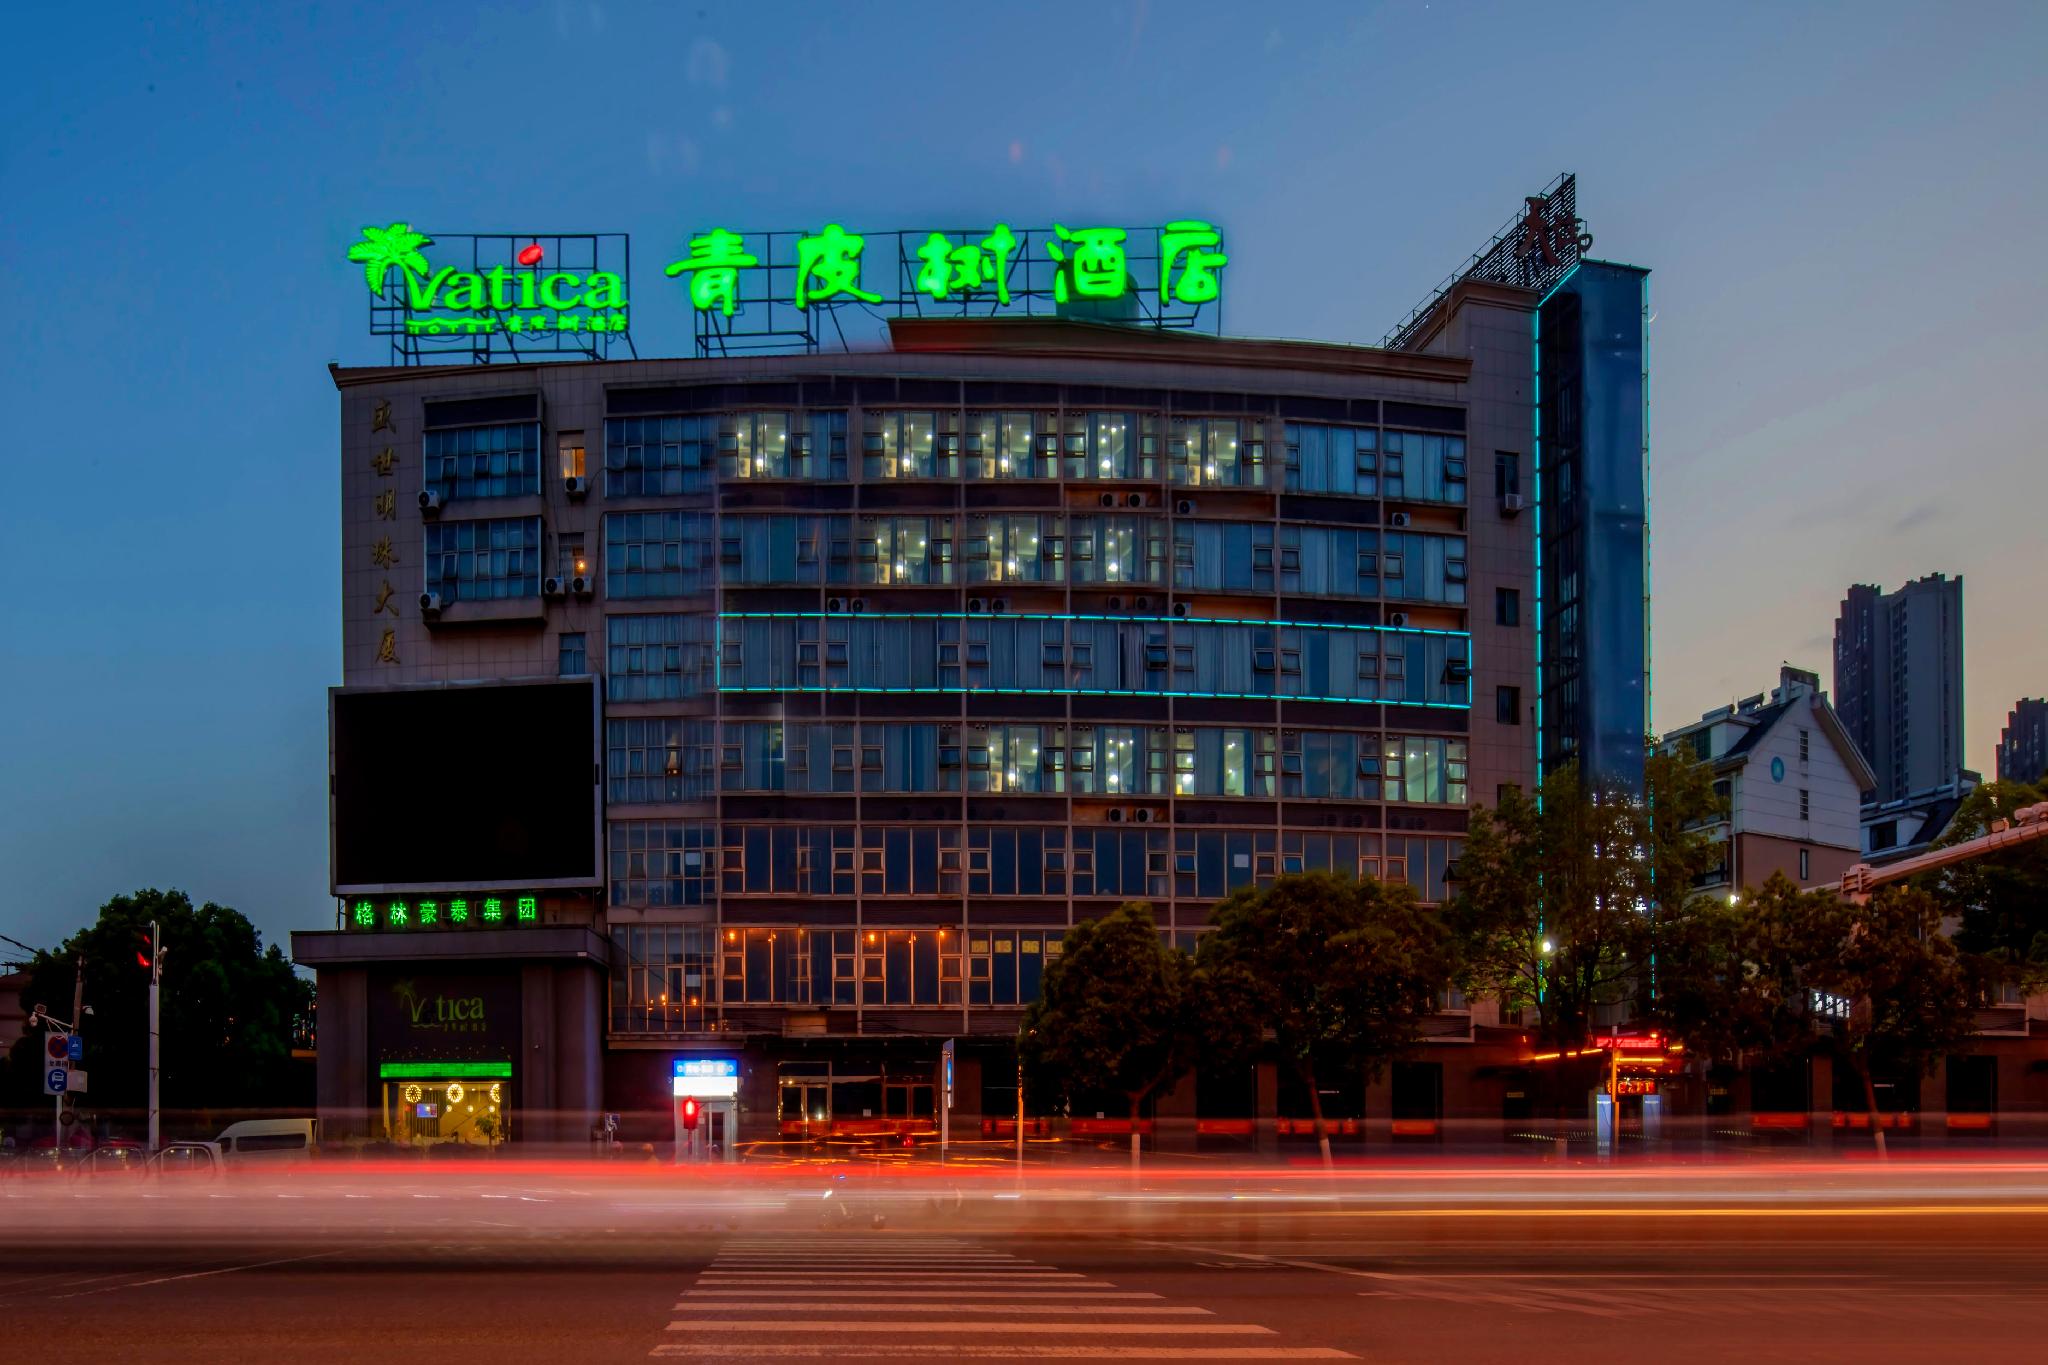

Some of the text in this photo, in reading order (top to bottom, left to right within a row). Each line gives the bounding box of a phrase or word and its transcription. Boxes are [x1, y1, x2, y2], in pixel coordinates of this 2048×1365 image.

[403, 245, 627, 311] Vatica
[665, 221, 1227, 317] 青皮树酒店
[355, 898, 535, 925] 格林豪泰集团
[408, 993, 485, 1023] Vtica
